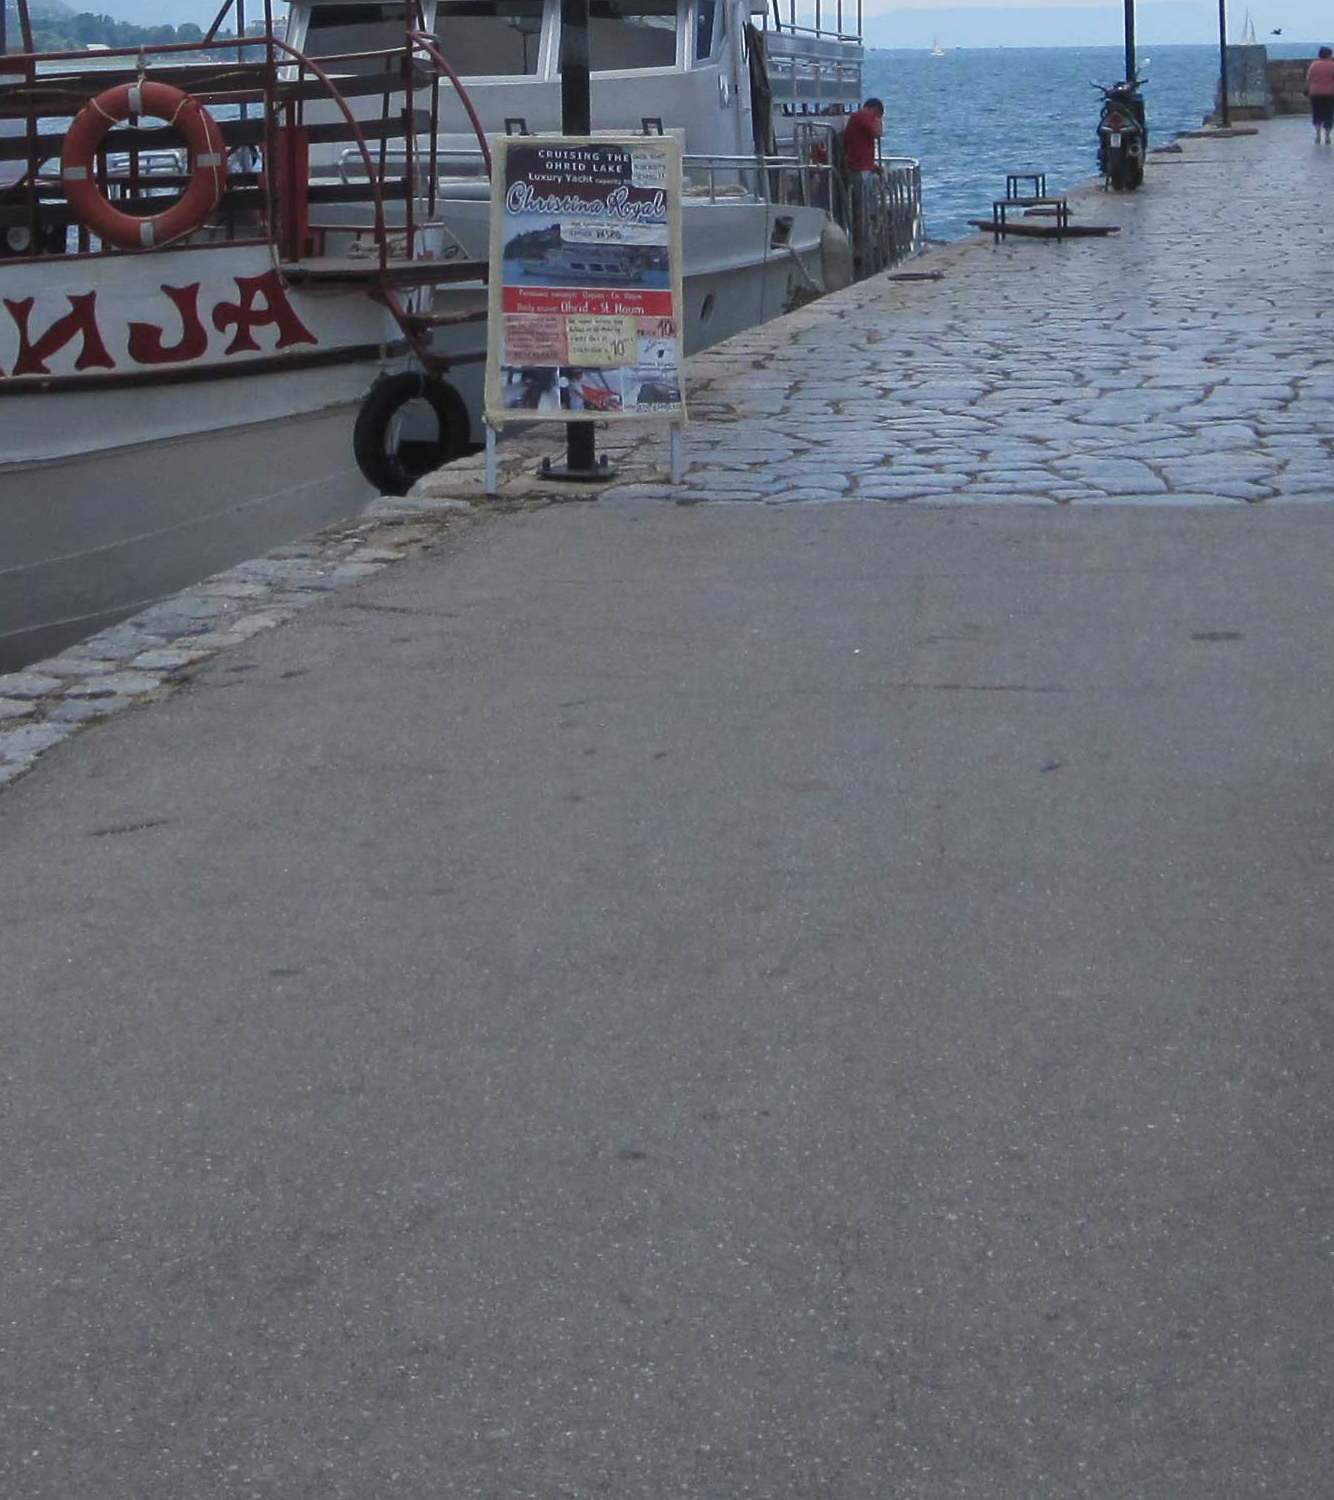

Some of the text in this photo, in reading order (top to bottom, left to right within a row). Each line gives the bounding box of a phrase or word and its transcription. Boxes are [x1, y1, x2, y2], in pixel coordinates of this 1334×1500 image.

[538, 149, 630, 163] CRUISING THE
[545, 161, 623, 174] OHRID LAKE
[528, 172, 563, 184] Luxury
[565, 173, 594, 184] Yacht
[507, 180, 667, 225] Christina Royal
[560, 301, 589, 314] Ohrid
